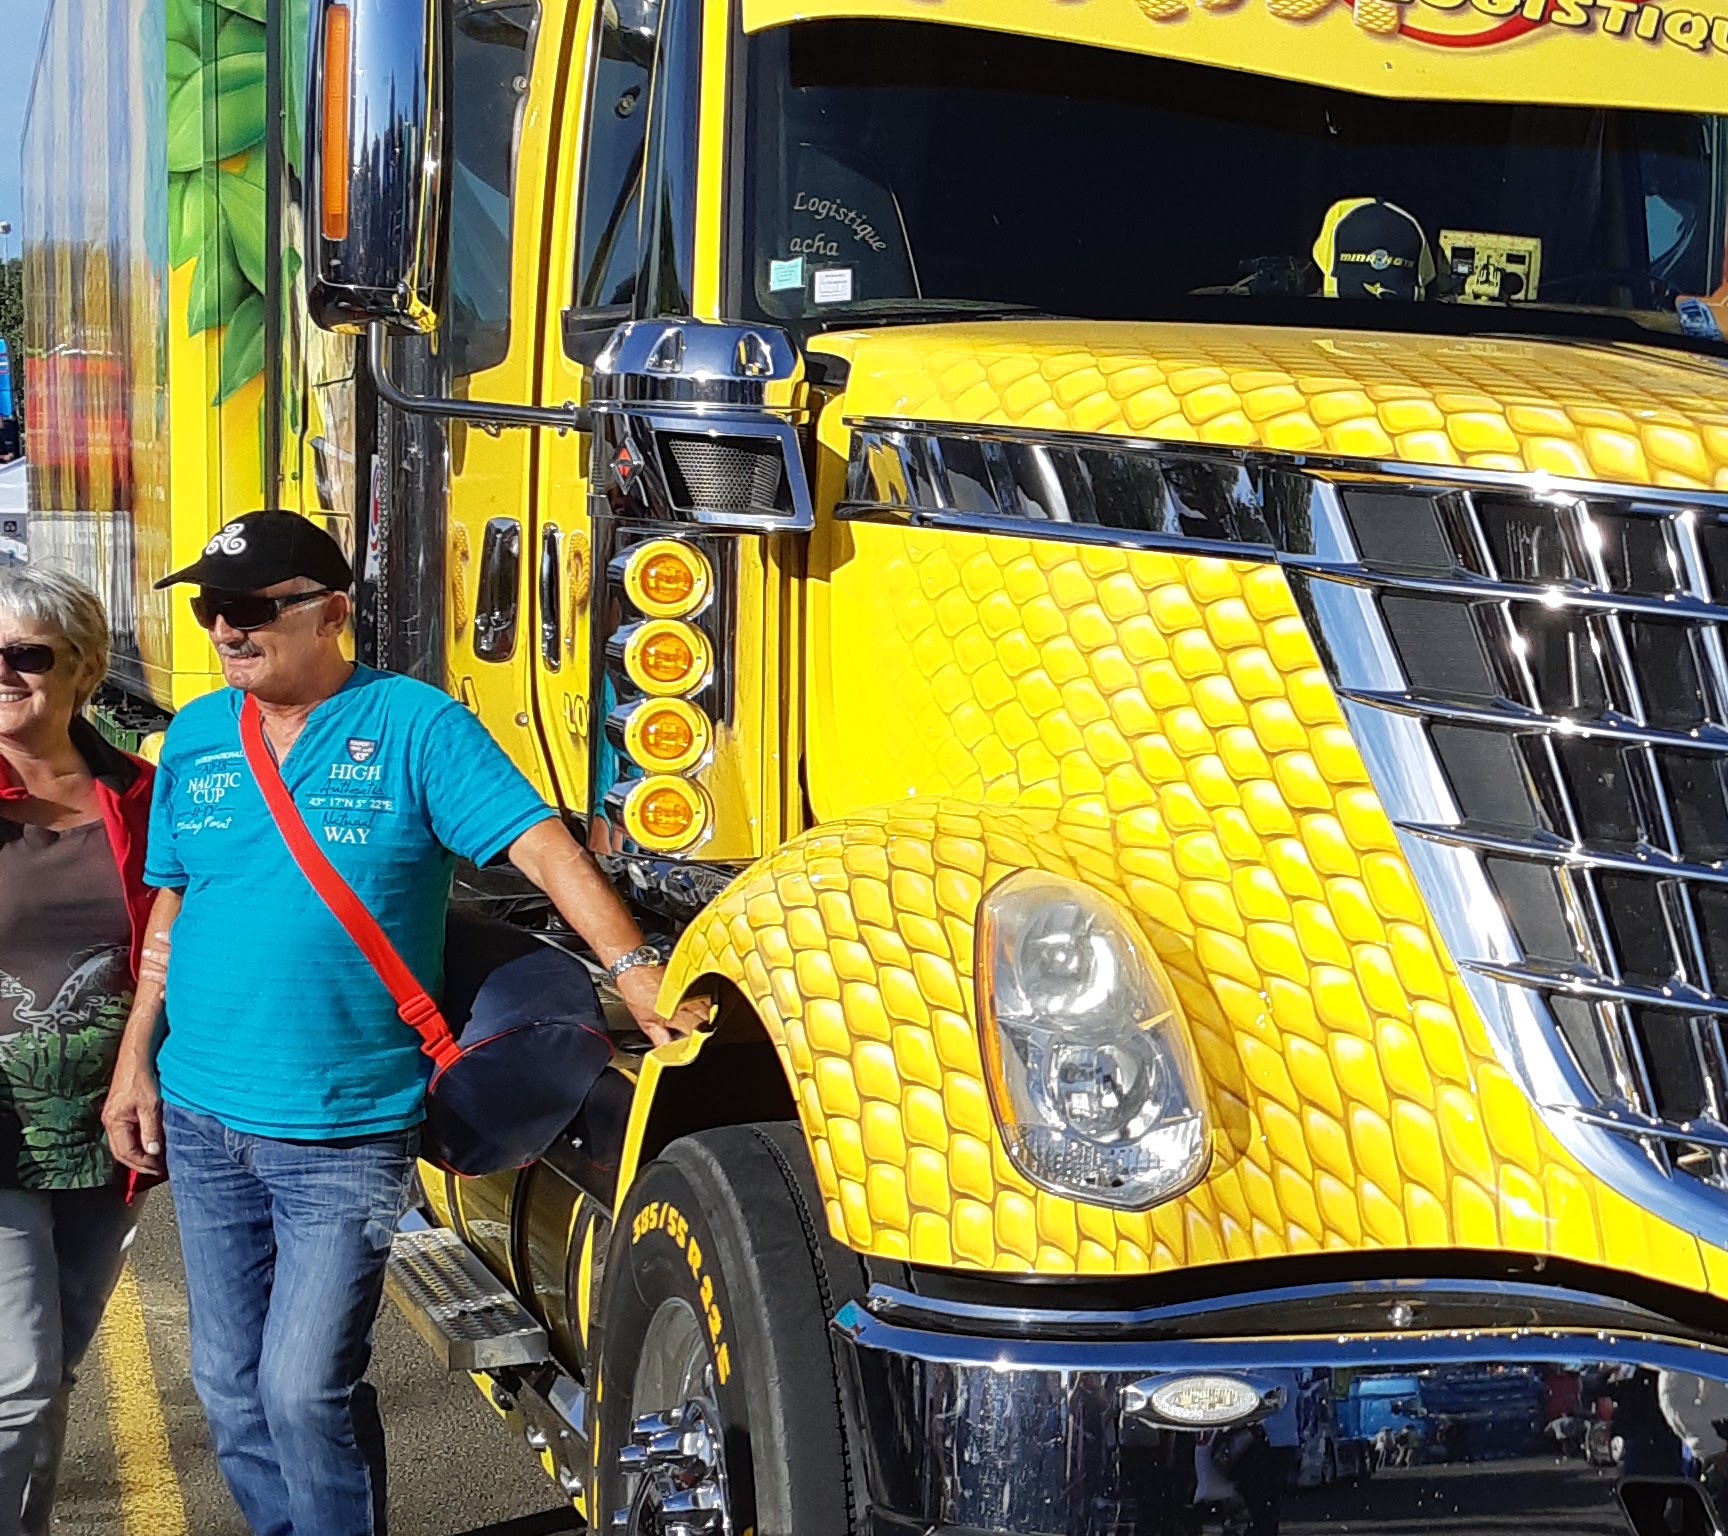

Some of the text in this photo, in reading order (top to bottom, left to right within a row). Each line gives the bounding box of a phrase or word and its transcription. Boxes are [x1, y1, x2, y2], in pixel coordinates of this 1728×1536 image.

[793, 191, 887, 253] Logistique
[328, 763, 383, 781] HIGH
[186, 772, 242, 794] NAUTIC
[193, 788, 226, 805] CUP
[323, 825, 372, 845] WAY
